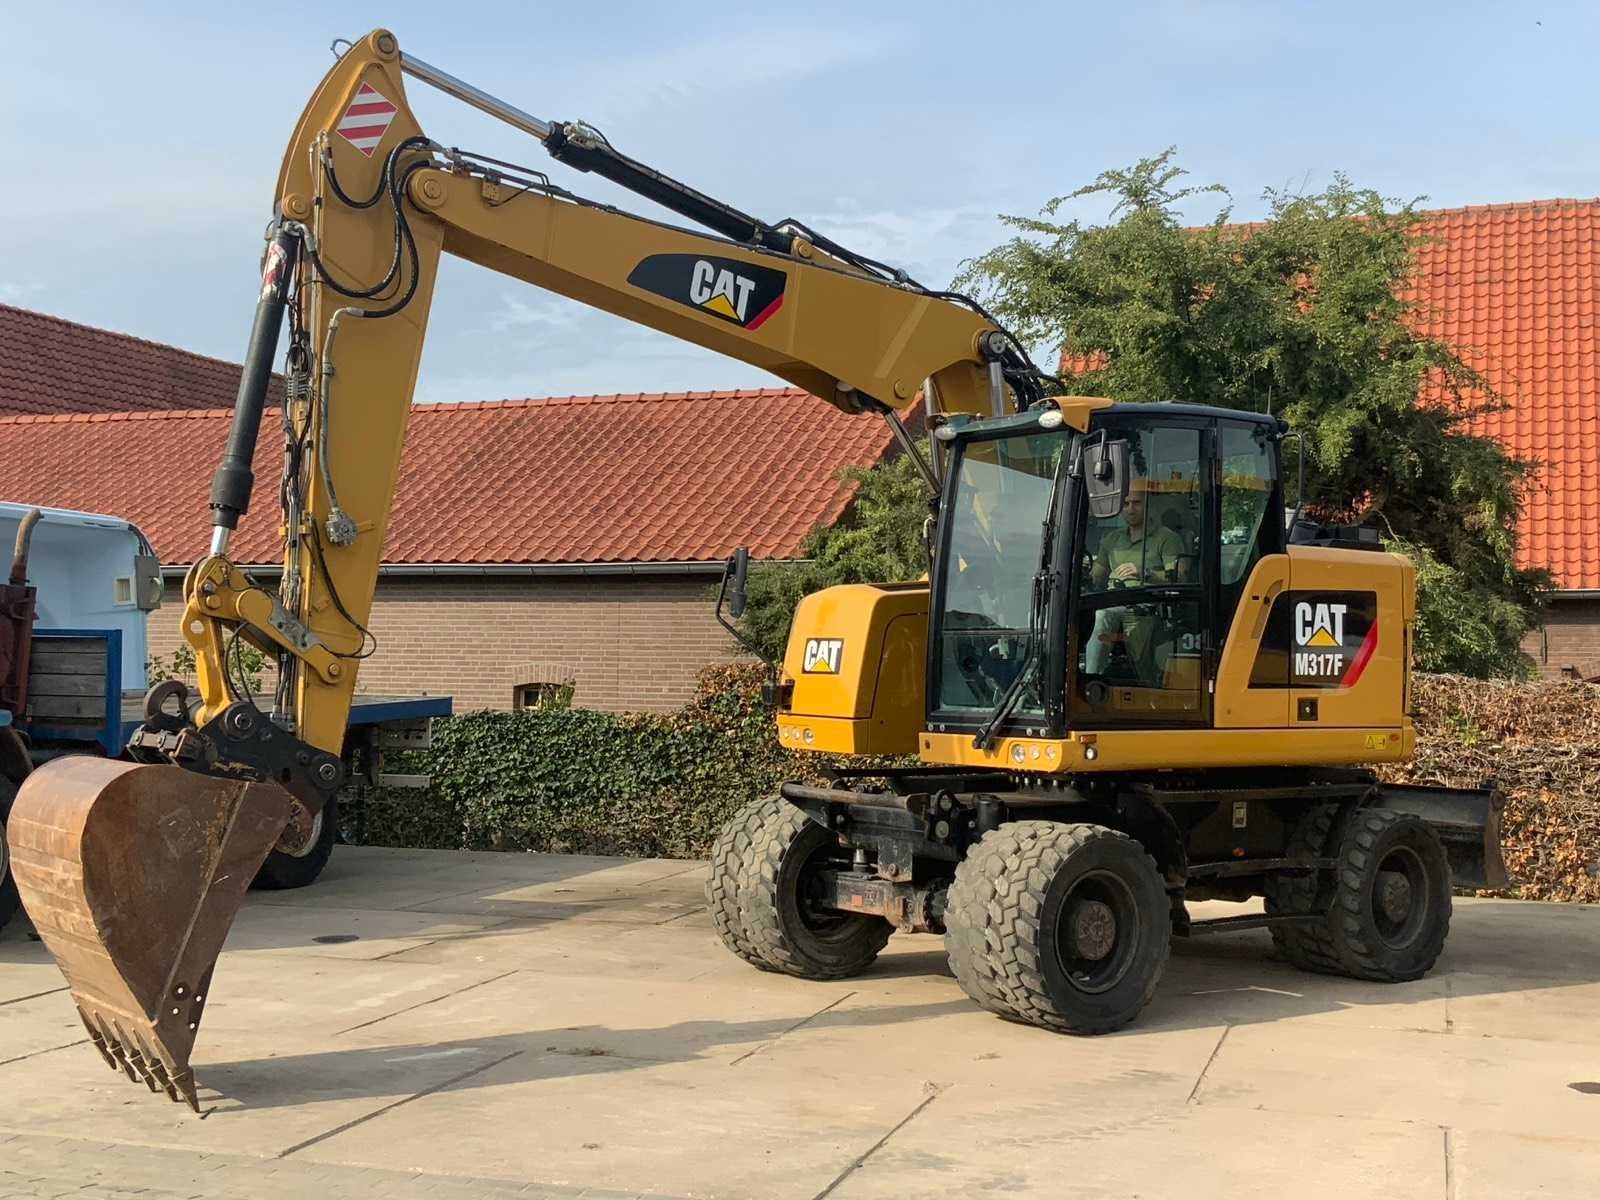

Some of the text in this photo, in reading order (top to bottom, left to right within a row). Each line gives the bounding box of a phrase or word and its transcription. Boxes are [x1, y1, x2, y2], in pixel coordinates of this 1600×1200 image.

[690, 260, 756, 322] CAT
[1295, 602, 1347, 647] CAT
[804, 640, 842, 672] CAT
[1295, 653, 1343, 676] M317F
